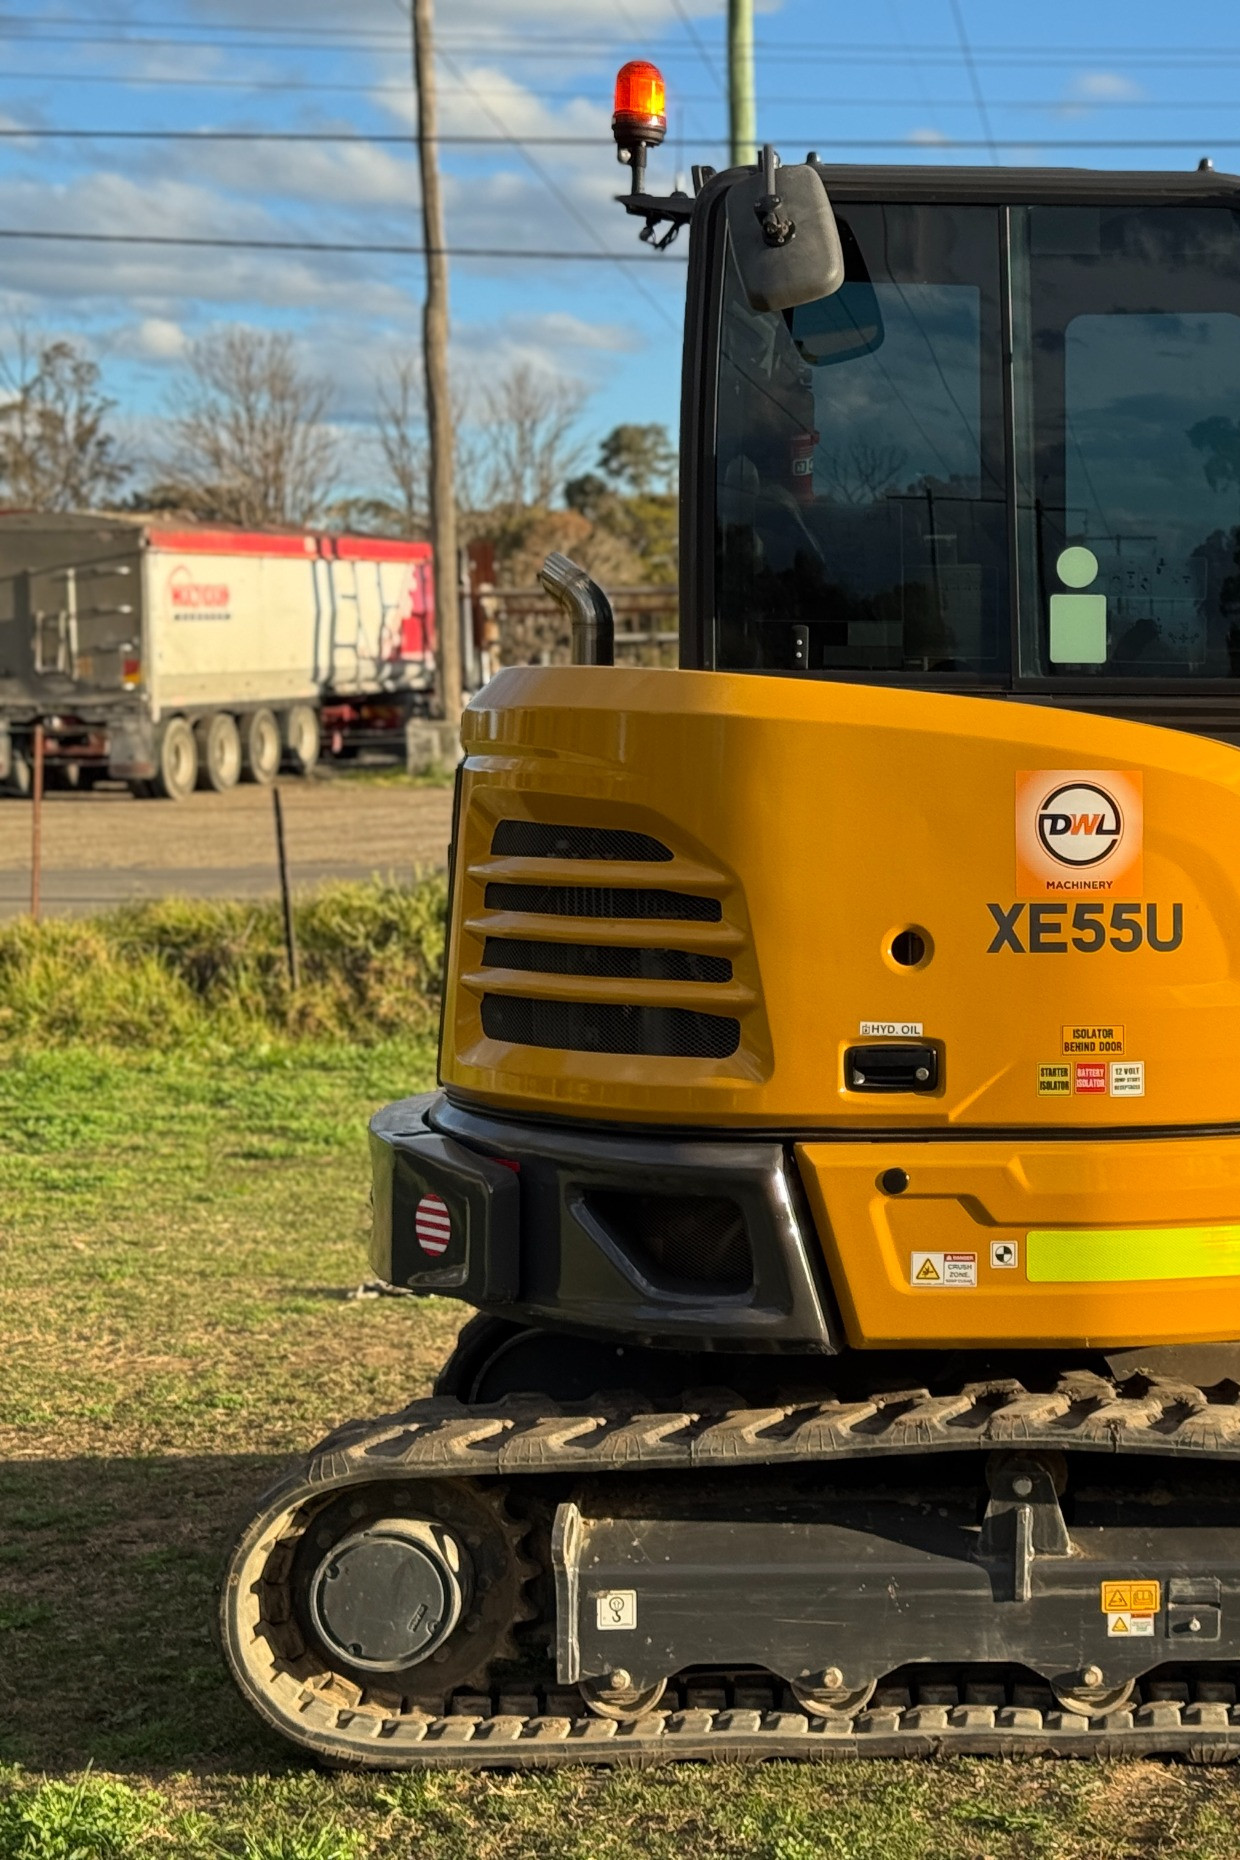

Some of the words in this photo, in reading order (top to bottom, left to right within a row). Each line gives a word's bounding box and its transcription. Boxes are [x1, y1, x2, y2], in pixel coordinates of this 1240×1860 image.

[1039, 813, 1121, 835] DWL
[1046, 881, 1113, 890] MACHINERY
[986, 903, 1183, 953] XE55U
[871, 1024, 899, 1034] HYD.
[901, 1025, 920, 1034] OIL
[1072, 1028, 1114, 1039] ISOLATOR
[1064, 1042, 1096, 1052] BEHIND
[1098, 1041, 1123, 1052] DOOR
[1040, 1067, 1068, 1077] STARTER
[1077, 1068, 1104, 1077] BATTERY
[1115, 1067, 1122, 1075] 12
[1123, 1067, 1140, 1075] VOLT
[1039, 1080, 1070, 1091] ISOLATOR
[1076, 1079, 1105, 1088] ISOLATOR
